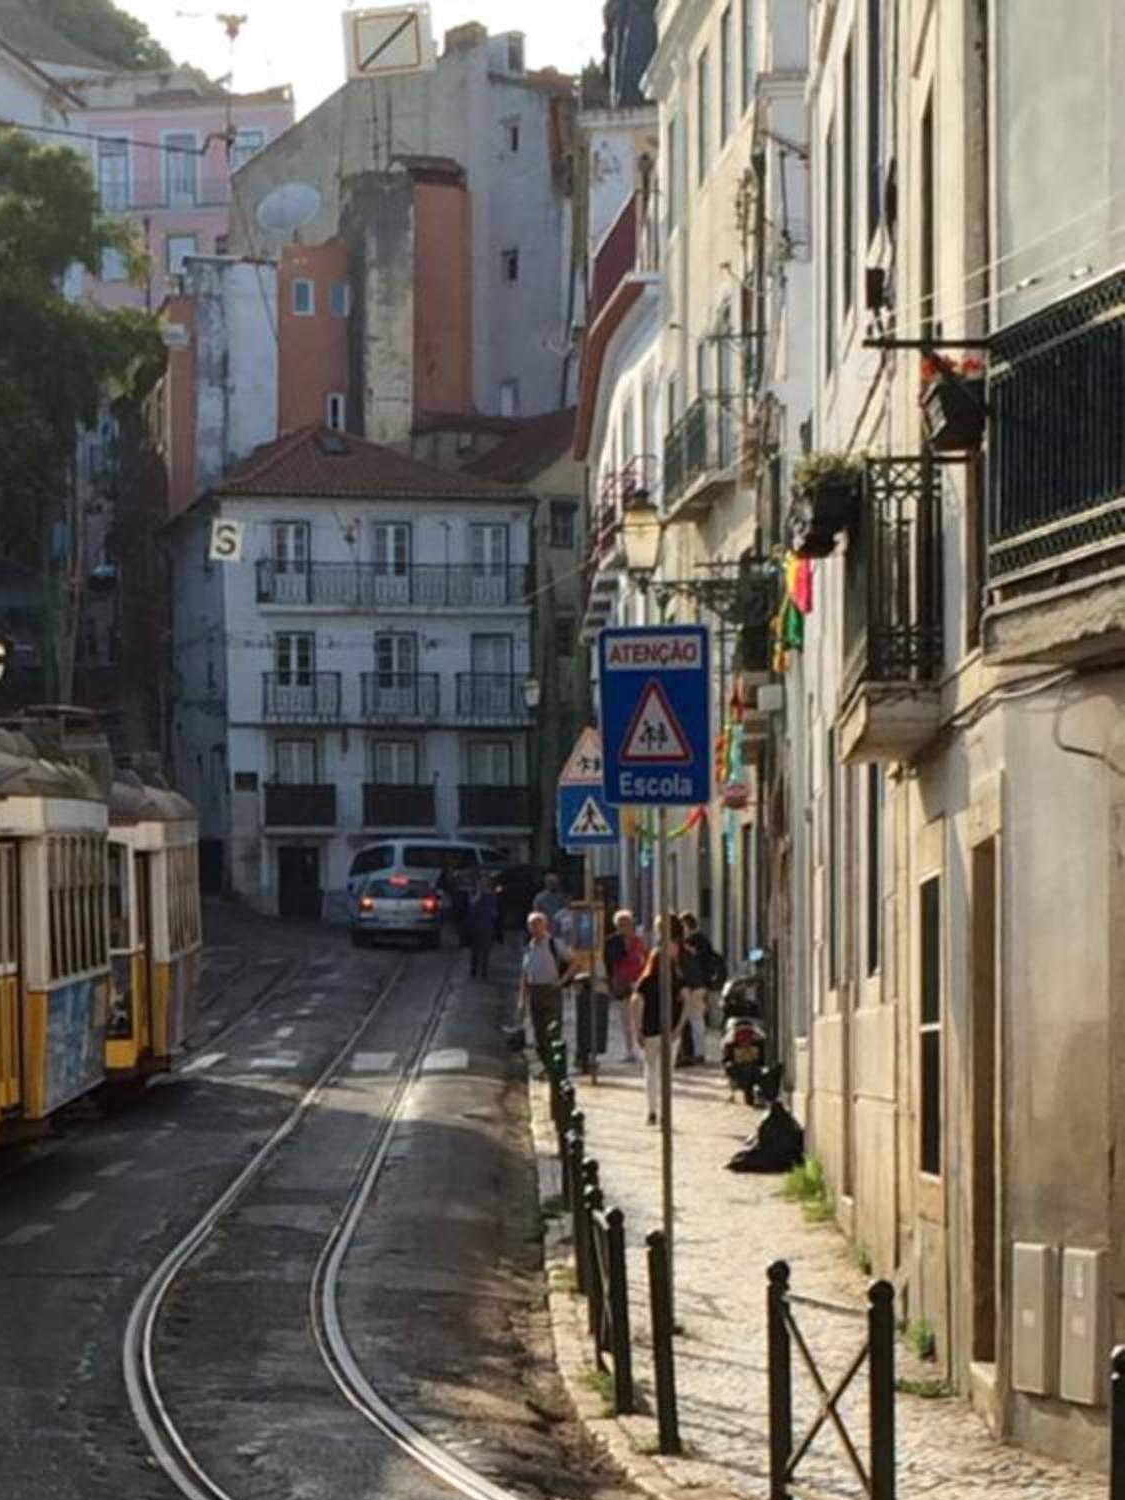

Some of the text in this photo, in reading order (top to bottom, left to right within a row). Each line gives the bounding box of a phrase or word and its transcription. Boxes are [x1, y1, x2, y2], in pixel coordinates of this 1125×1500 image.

[215, 525, 236, 555] S
[609, 638, 697, 665] ATENÇÃO
[619, 771, 693, 796] Escola
